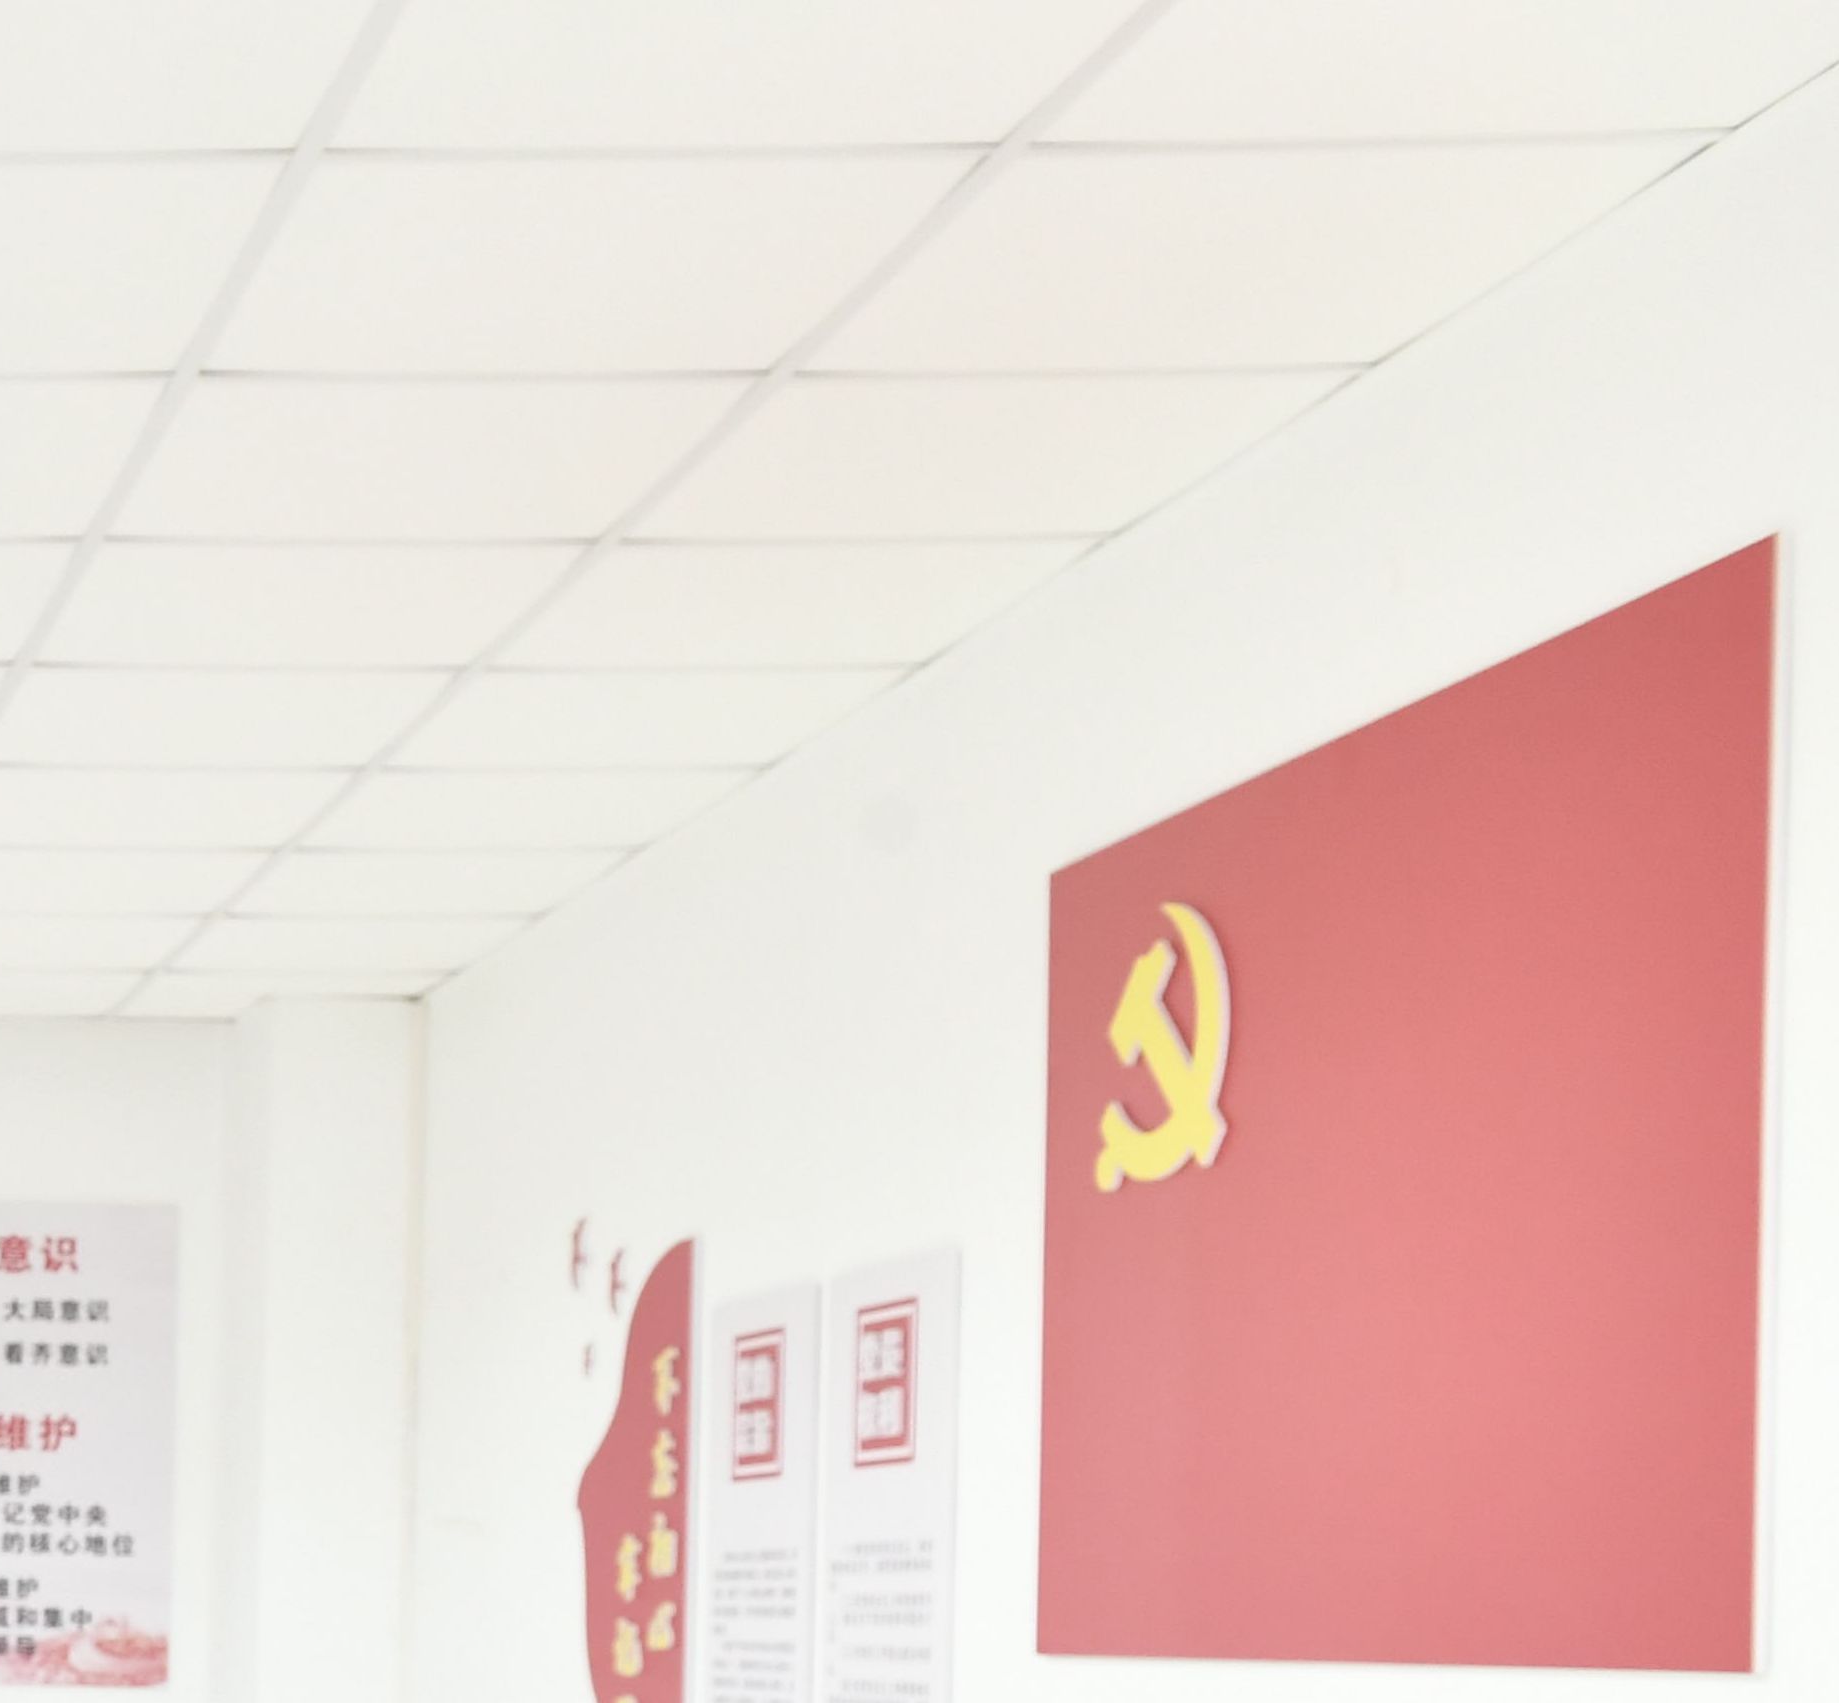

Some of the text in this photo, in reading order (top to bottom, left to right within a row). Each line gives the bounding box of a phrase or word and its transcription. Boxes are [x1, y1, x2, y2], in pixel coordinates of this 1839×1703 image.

[4, 1298, 110, 1322] 大局意识
[5, 1341, 109, 1366] 看齐意识
